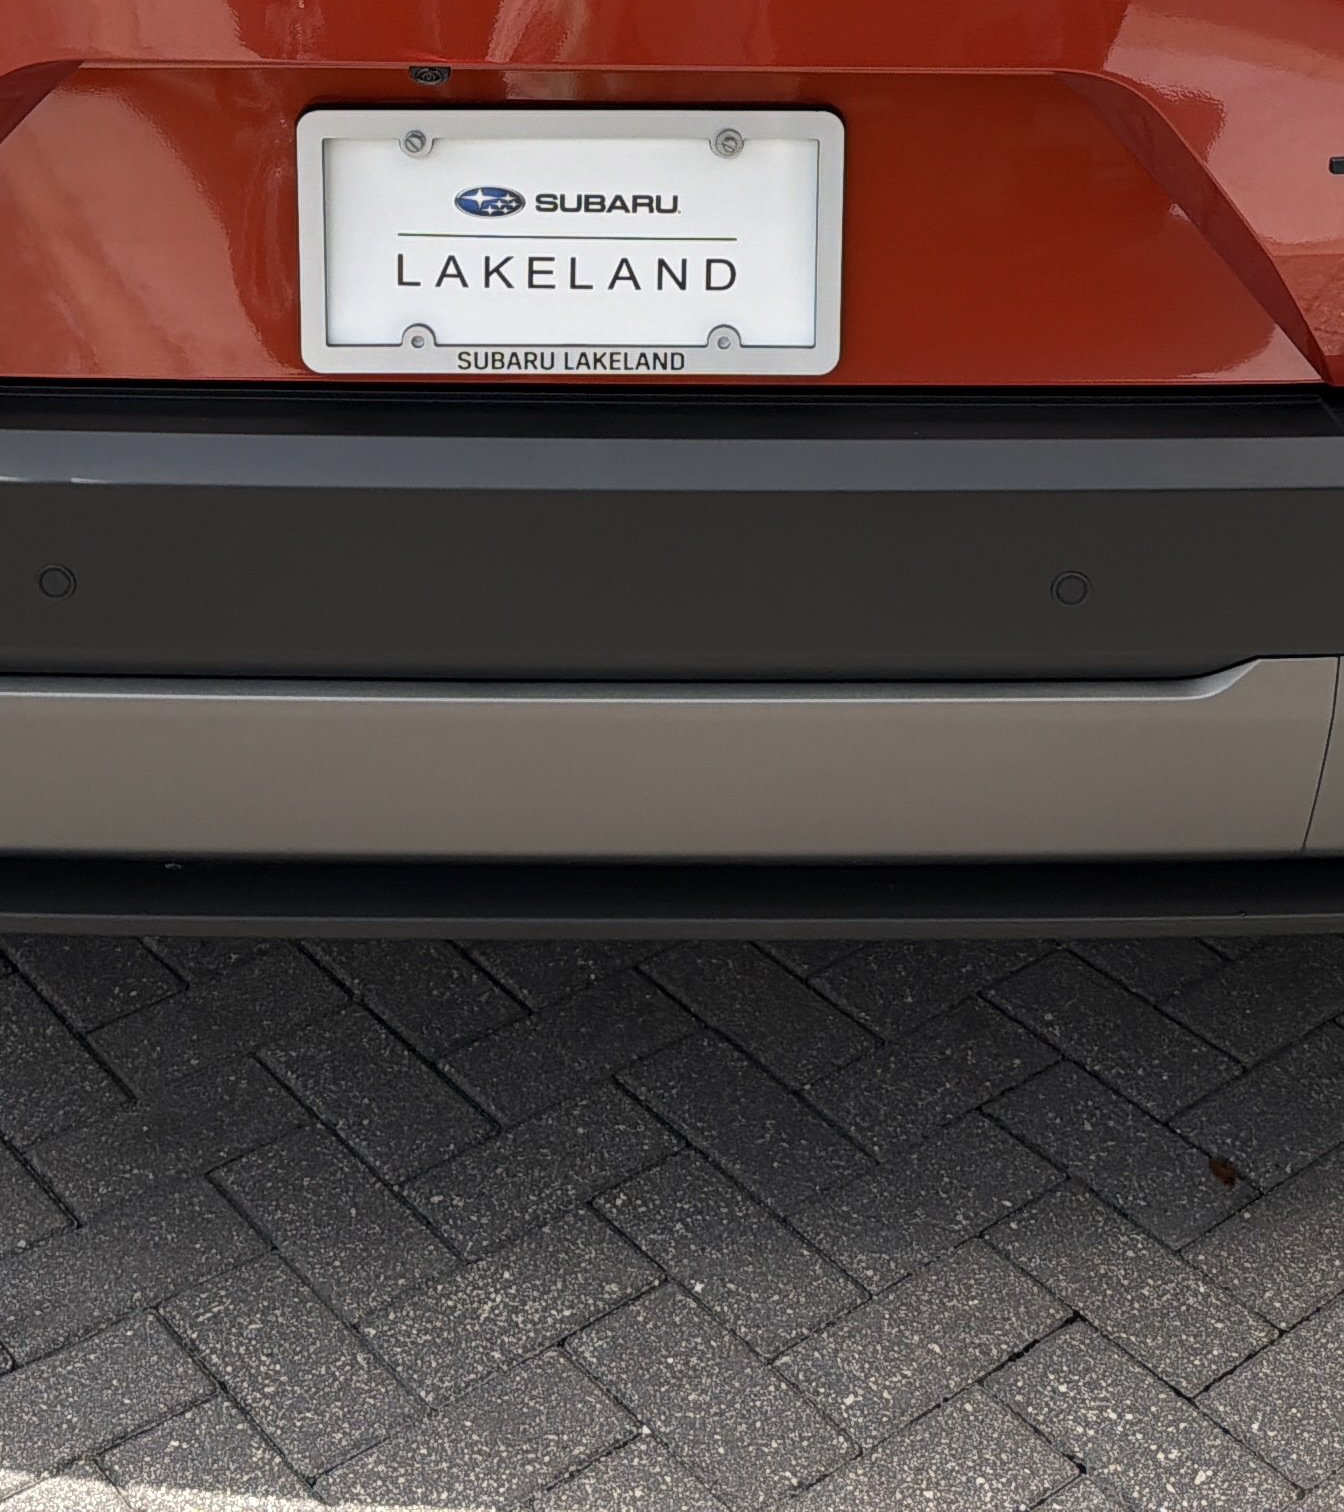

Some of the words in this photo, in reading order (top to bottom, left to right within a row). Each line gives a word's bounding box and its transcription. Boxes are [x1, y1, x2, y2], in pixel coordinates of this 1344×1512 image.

[534, 193, 682, 215] SUBARU
[397, 253, 738, 291] LAKELAND
[457, 352, 556, 370] SUBARU
[563, 352, 686, 371] LAKELAND
